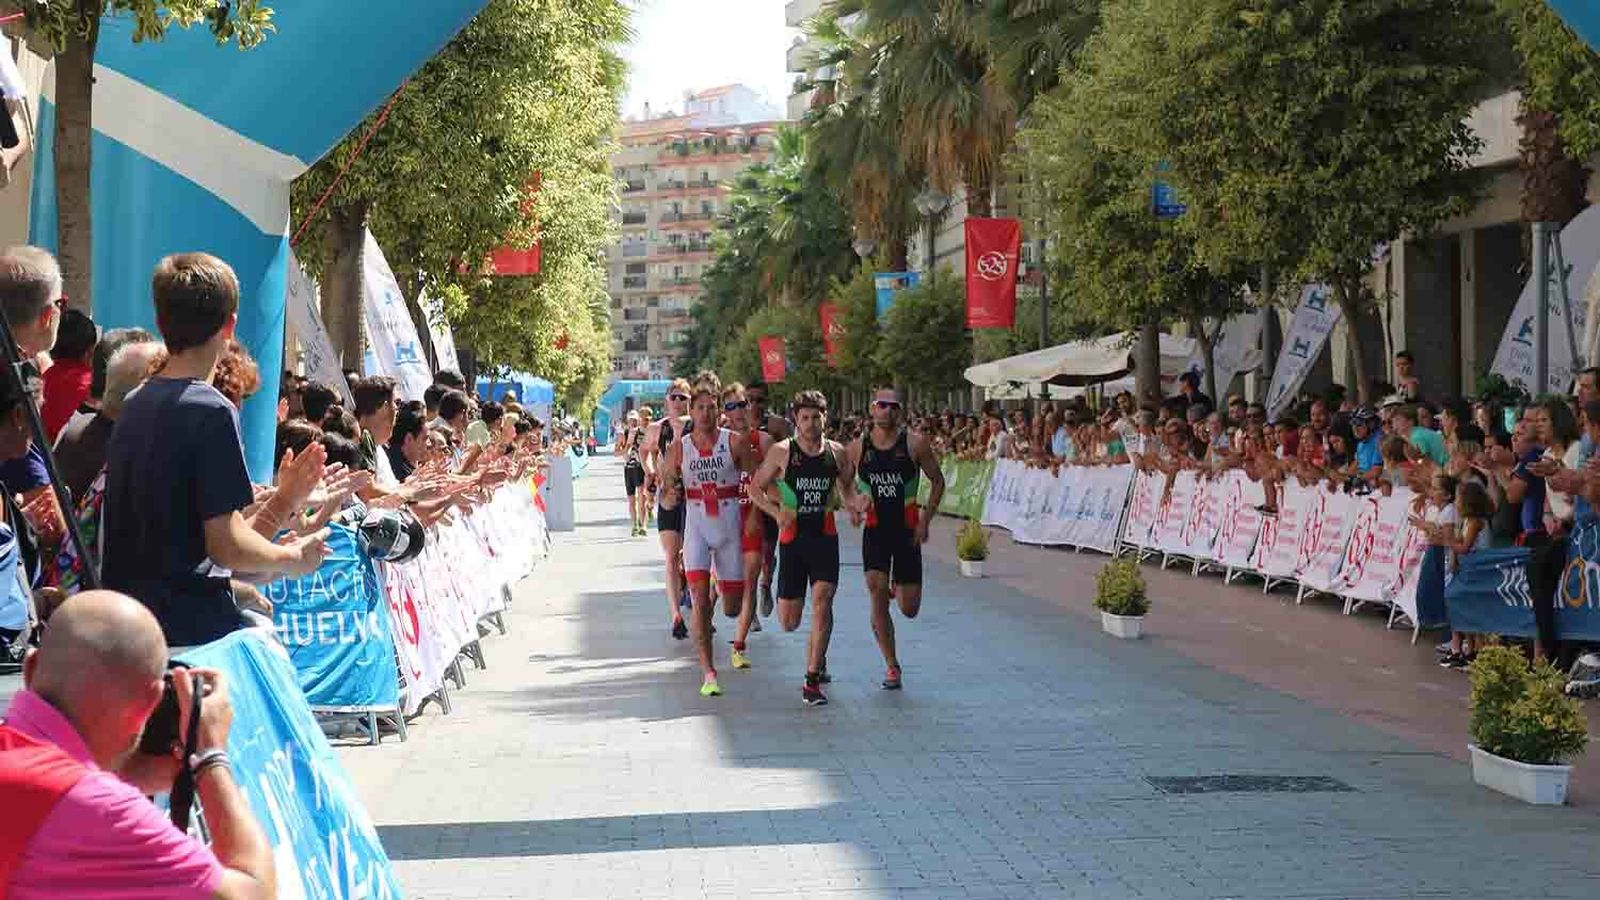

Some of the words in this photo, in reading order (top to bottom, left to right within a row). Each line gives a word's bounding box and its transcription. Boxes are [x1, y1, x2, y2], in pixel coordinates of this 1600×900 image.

[689, 457, 725, 471] GOMAR
[870, 472, 904, 485] PALMA
[803, 491, 821, 504] POR
[878, 485, 897, 498] POR
